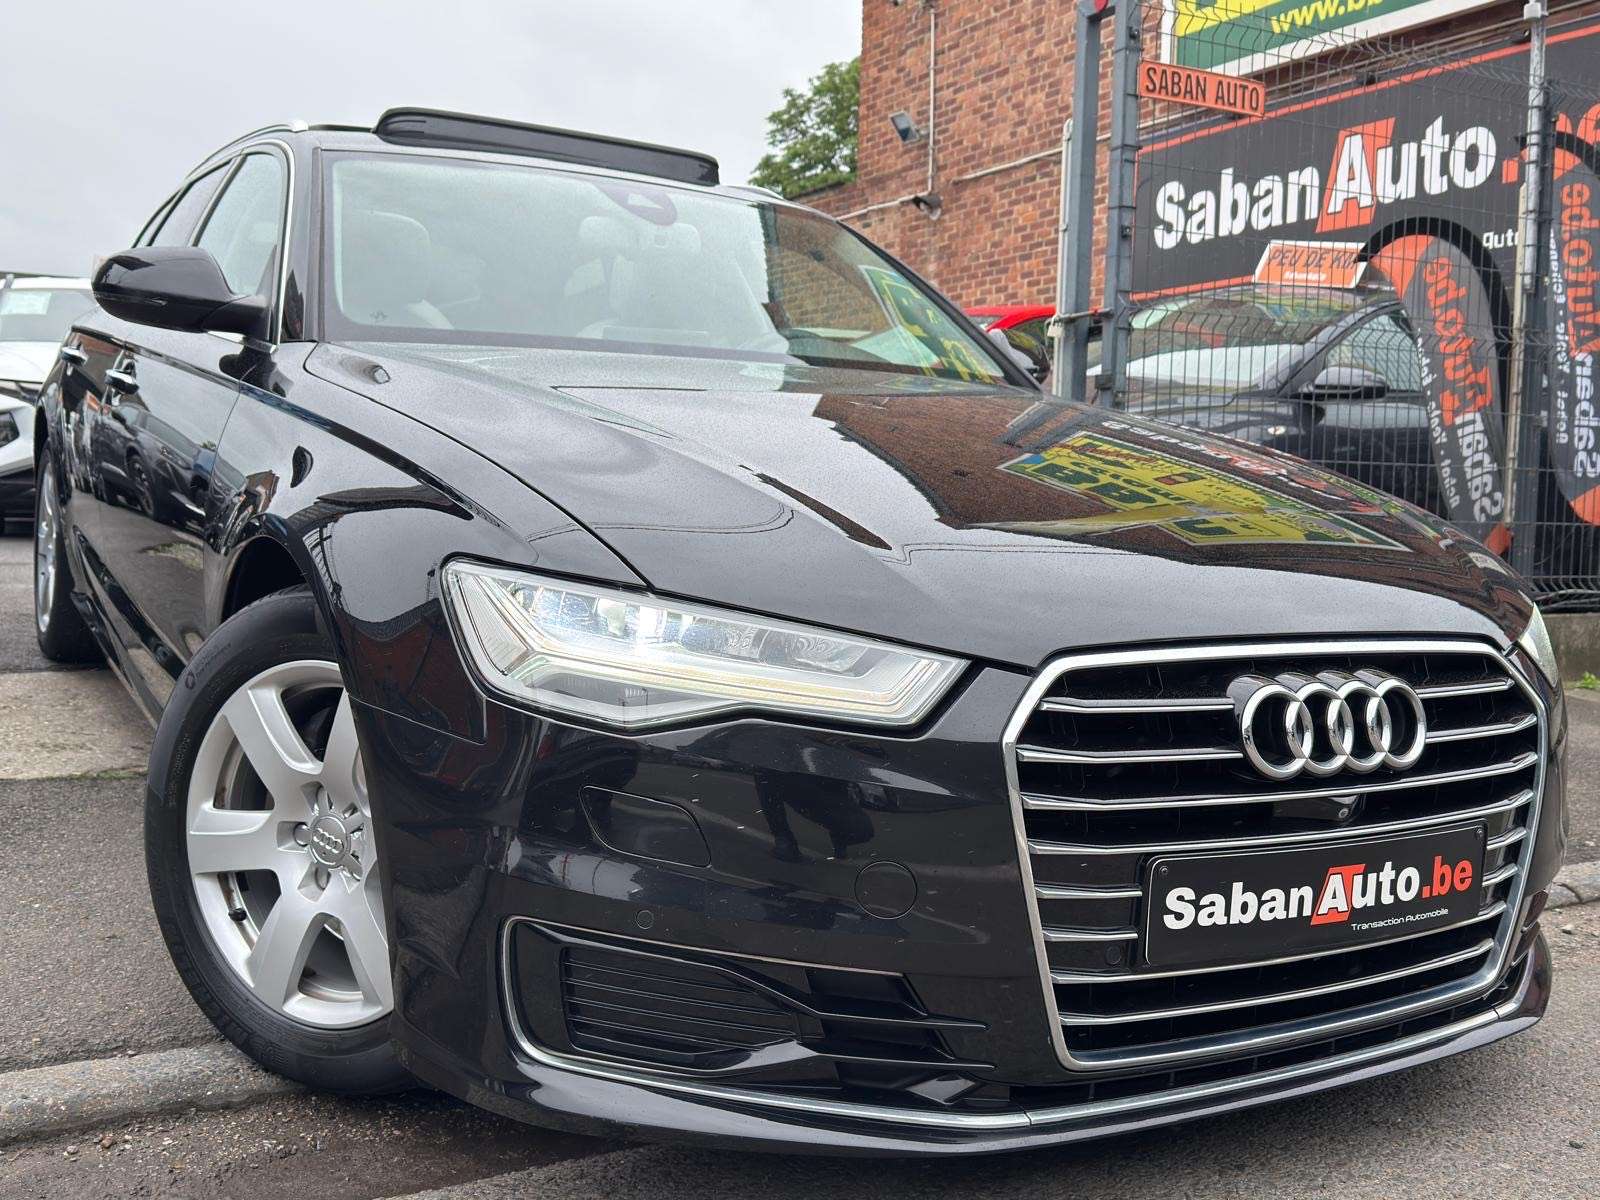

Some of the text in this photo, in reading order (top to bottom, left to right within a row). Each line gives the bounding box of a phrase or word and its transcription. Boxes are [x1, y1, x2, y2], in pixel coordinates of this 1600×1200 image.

[1270, 0, 1383, 34] www.b
[1145, 66, 1260, 112] SABAN AUTO
[1302, 248, 1333, 269] DE
[1163, 856, 1473, 930] SabanAuto.be
[1351, 906, 1449, 932] Transaction Automobile
